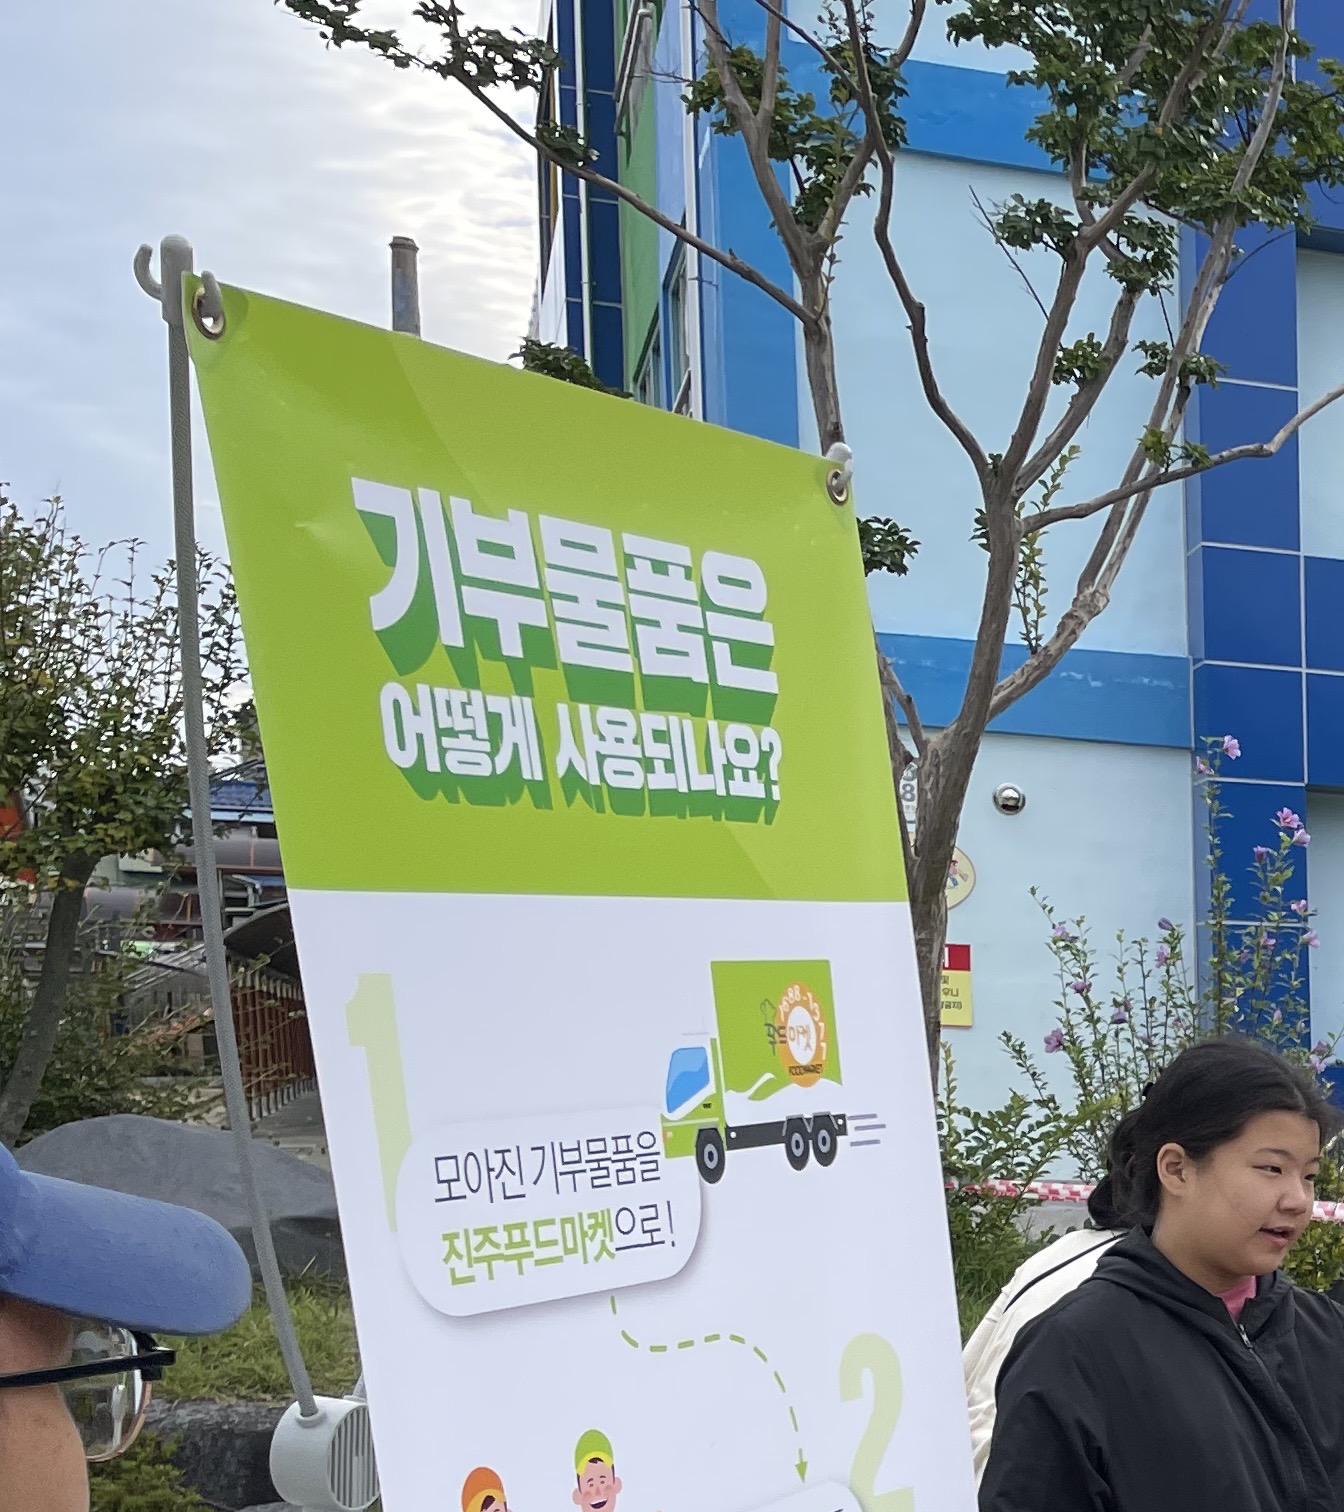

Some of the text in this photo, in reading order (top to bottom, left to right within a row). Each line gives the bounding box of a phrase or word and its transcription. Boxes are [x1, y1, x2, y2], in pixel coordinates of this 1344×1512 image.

[350, 477, 778, 697] 기부물품은
[379, 680, 783, 801] 어떻게 사용되나요?
[434, 1129, 662, 1203] 모아진 기부물품을
[441, 1200, 677, 1286] 진주푸드마켓으로!
